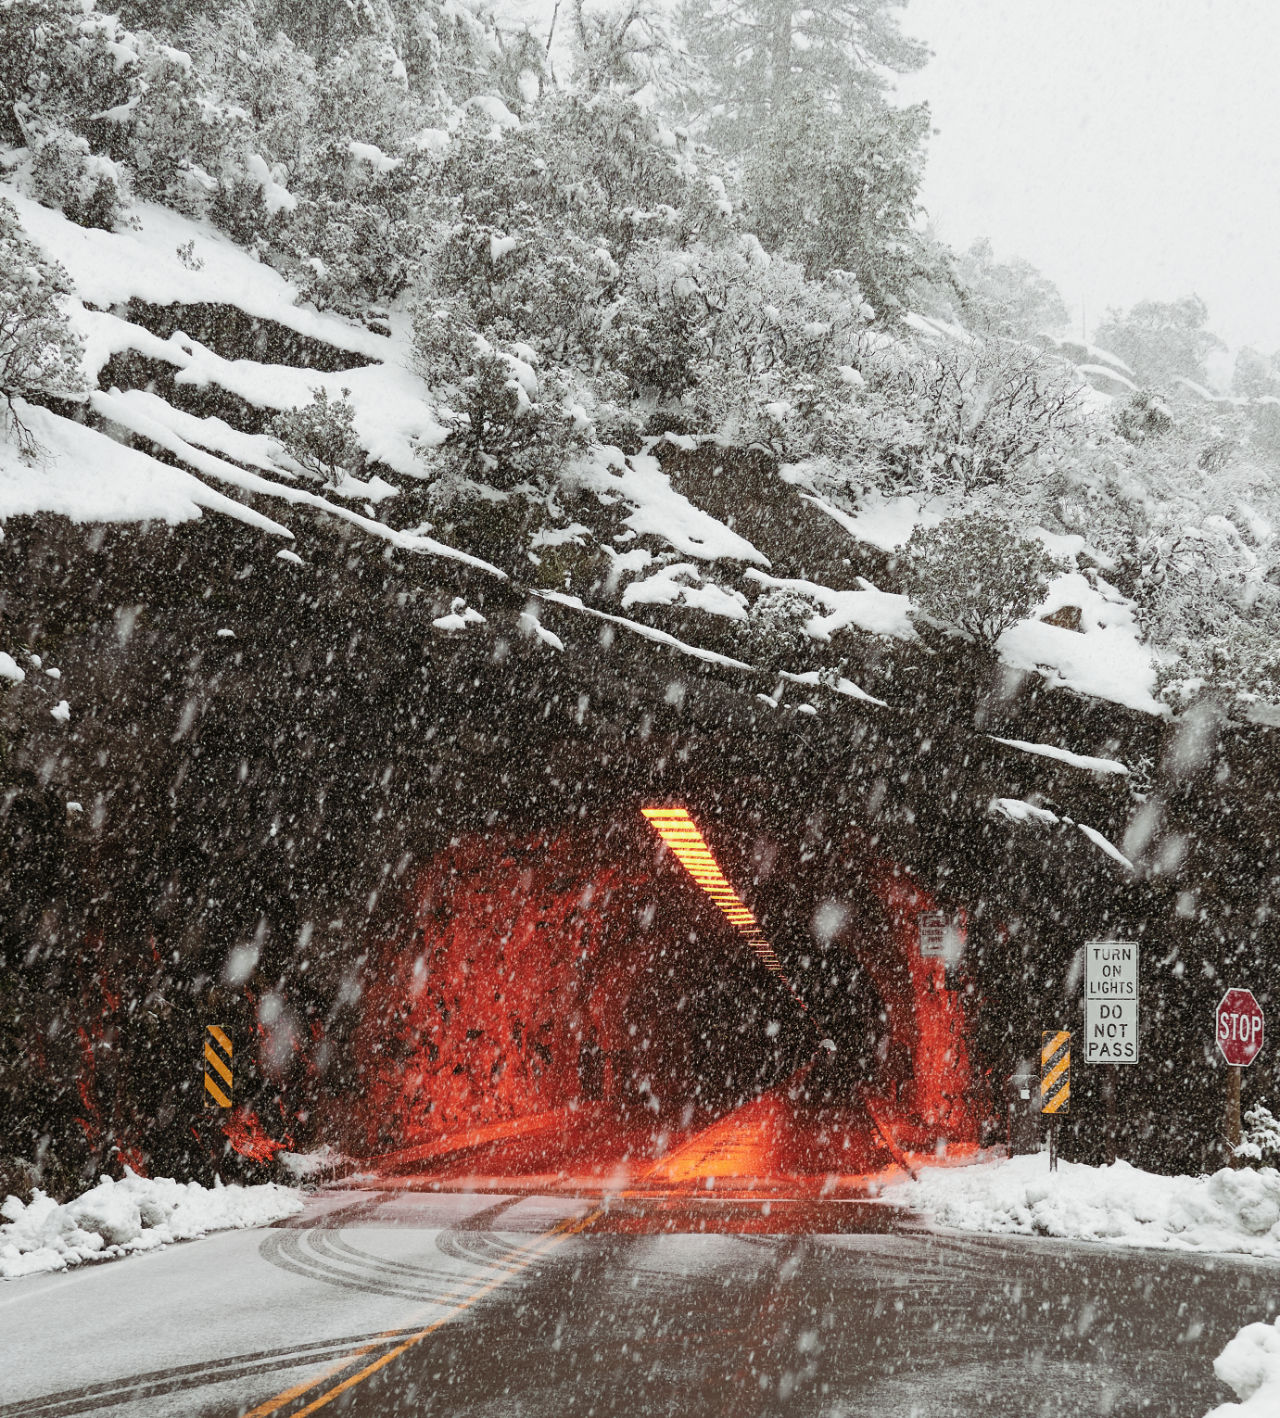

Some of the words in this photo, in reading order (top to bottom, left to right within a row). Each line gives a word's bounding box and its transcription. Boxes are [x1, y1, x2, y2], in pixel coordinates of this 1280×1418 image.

[1093, 948, 1131, 961] TURN
[1102, 965, 1122, 977] ON
[1090, 981, 1134, 994] LIGHTS
[1100, 1004, 1122, 1019] DO
[1094, 1023, 1128, 1038] NOT
[1219, 1011, 1262, 1042] STOP
[1088, 1042, 1134, 1057] PASS
